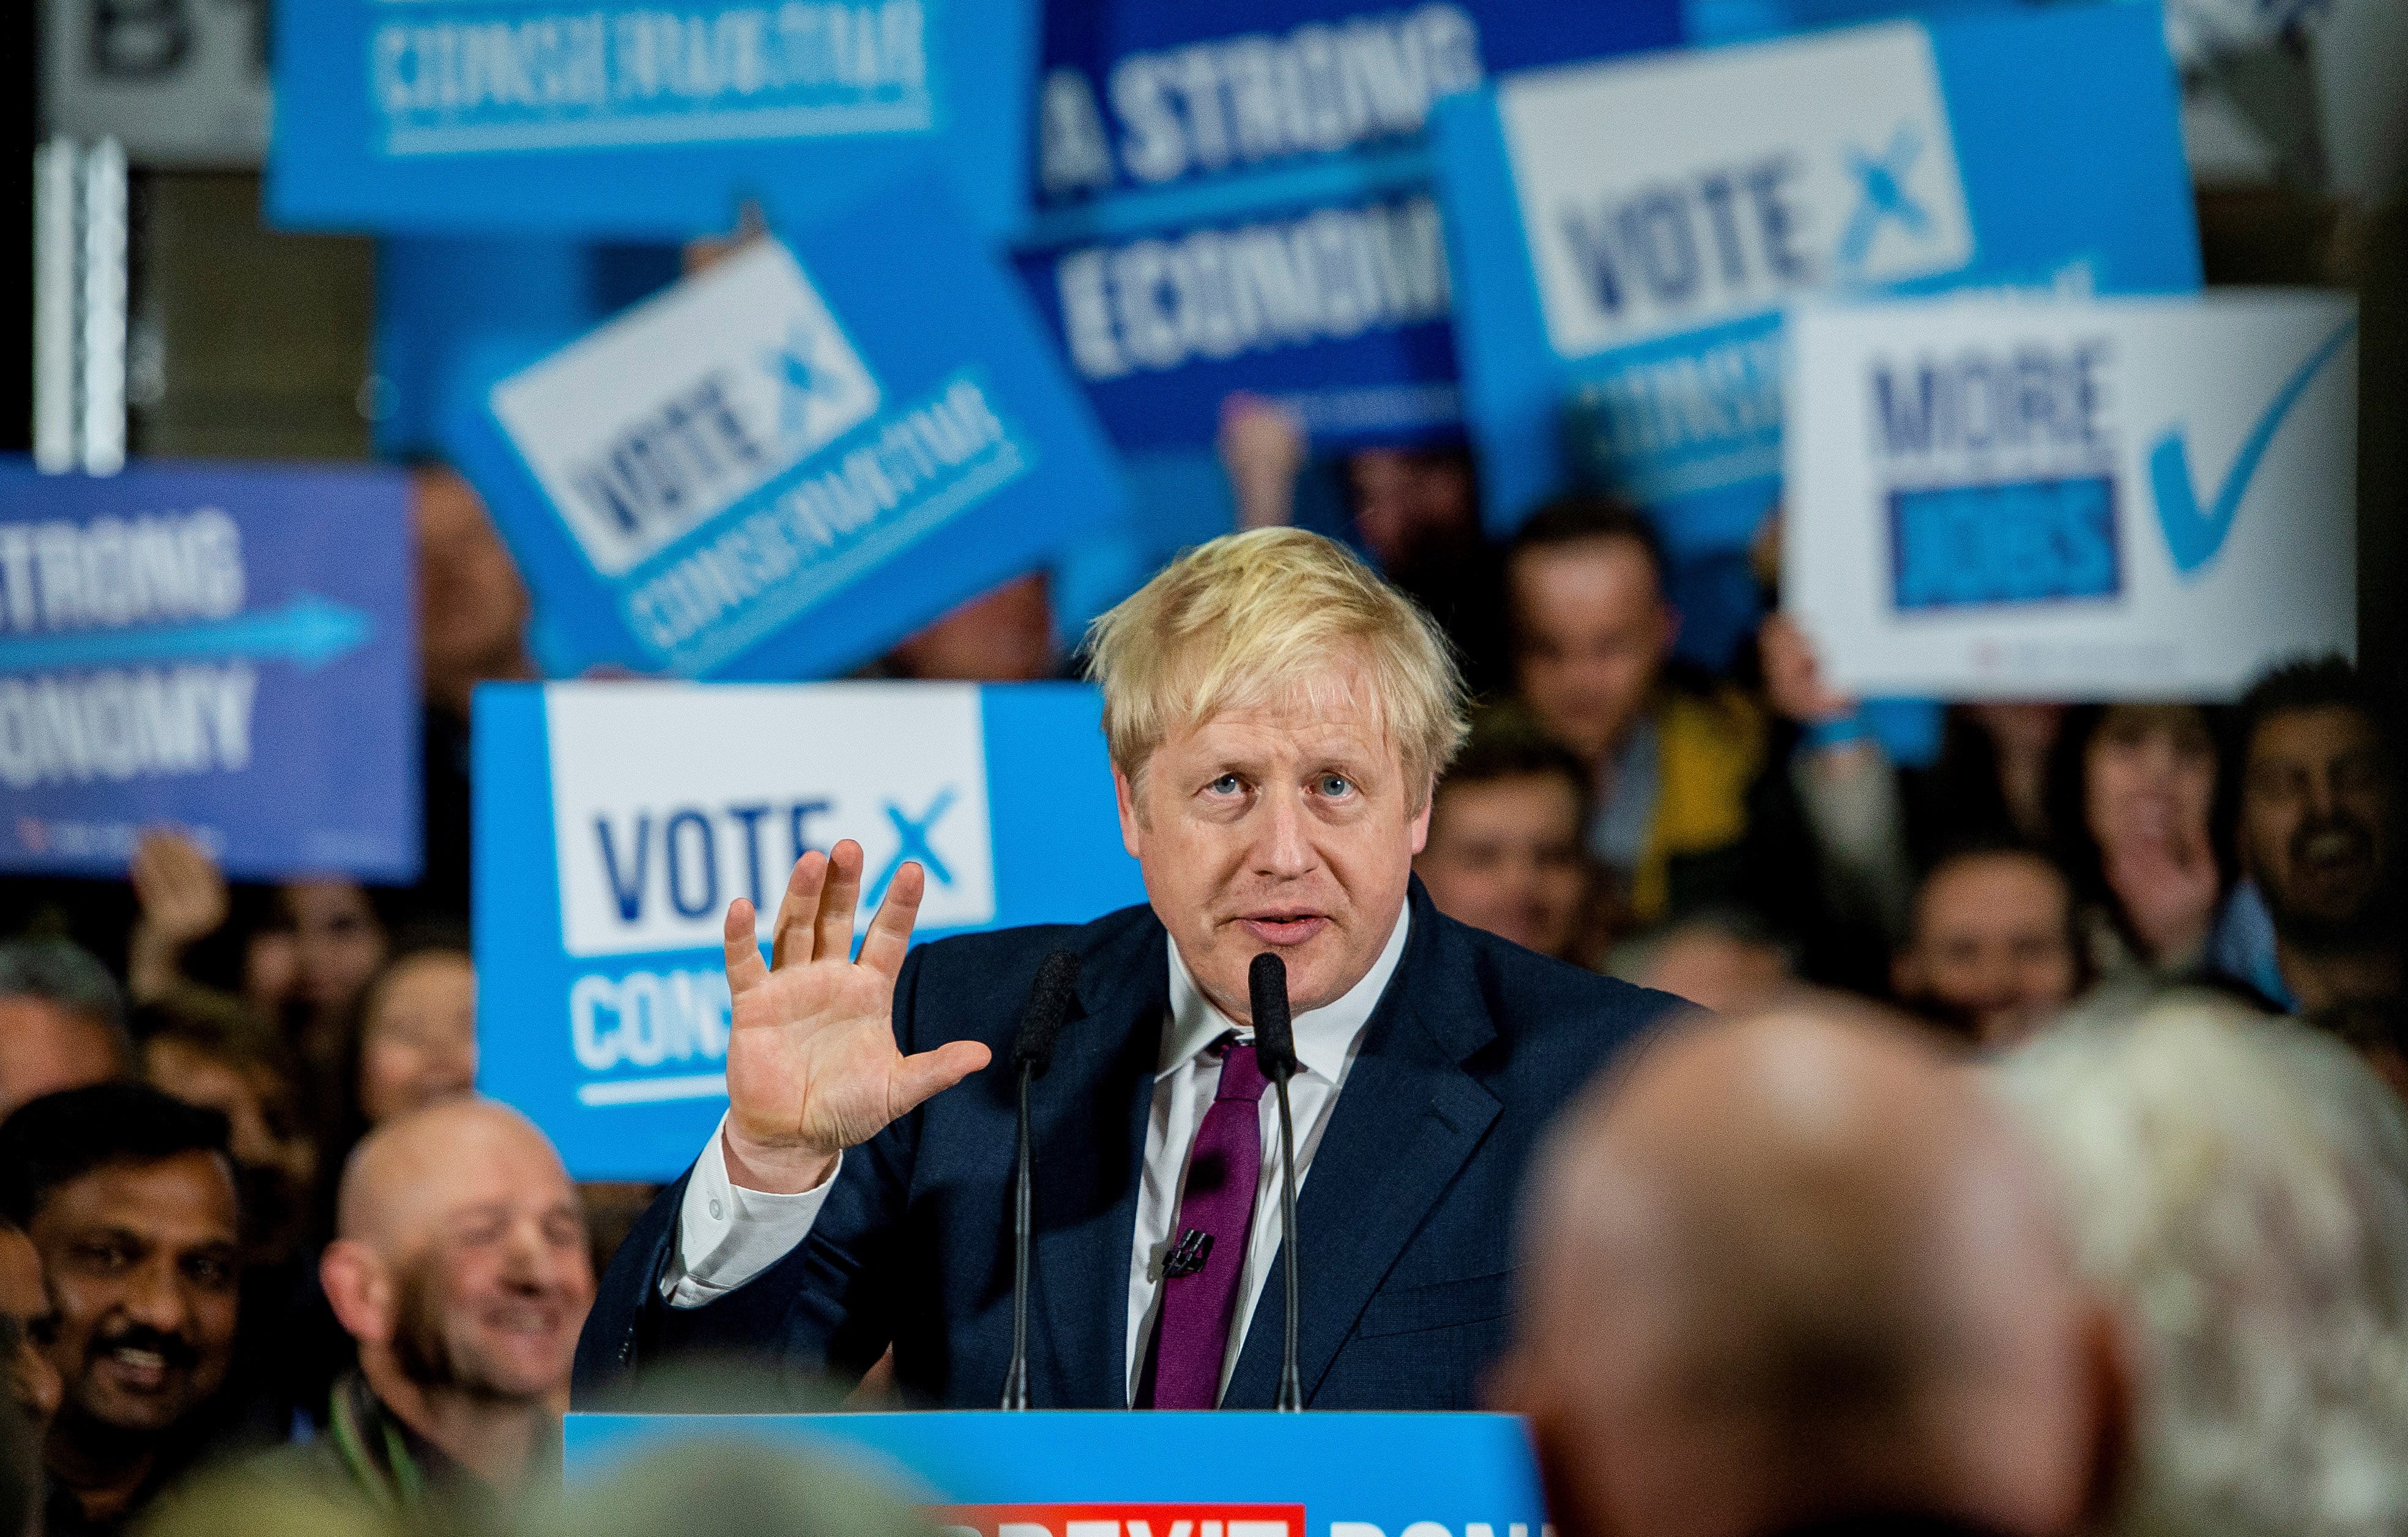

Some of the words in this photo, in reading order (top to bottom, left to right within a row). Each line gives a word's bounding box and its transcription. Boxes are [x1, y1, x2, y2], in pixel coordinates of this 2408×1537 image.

[1109, 3, 1479, 183] STRONG
[1559, 150, 1814, 315] VOTE
[572, 372, 770, 535] VOTE
[1867, 341, 2120, 456] MORE
